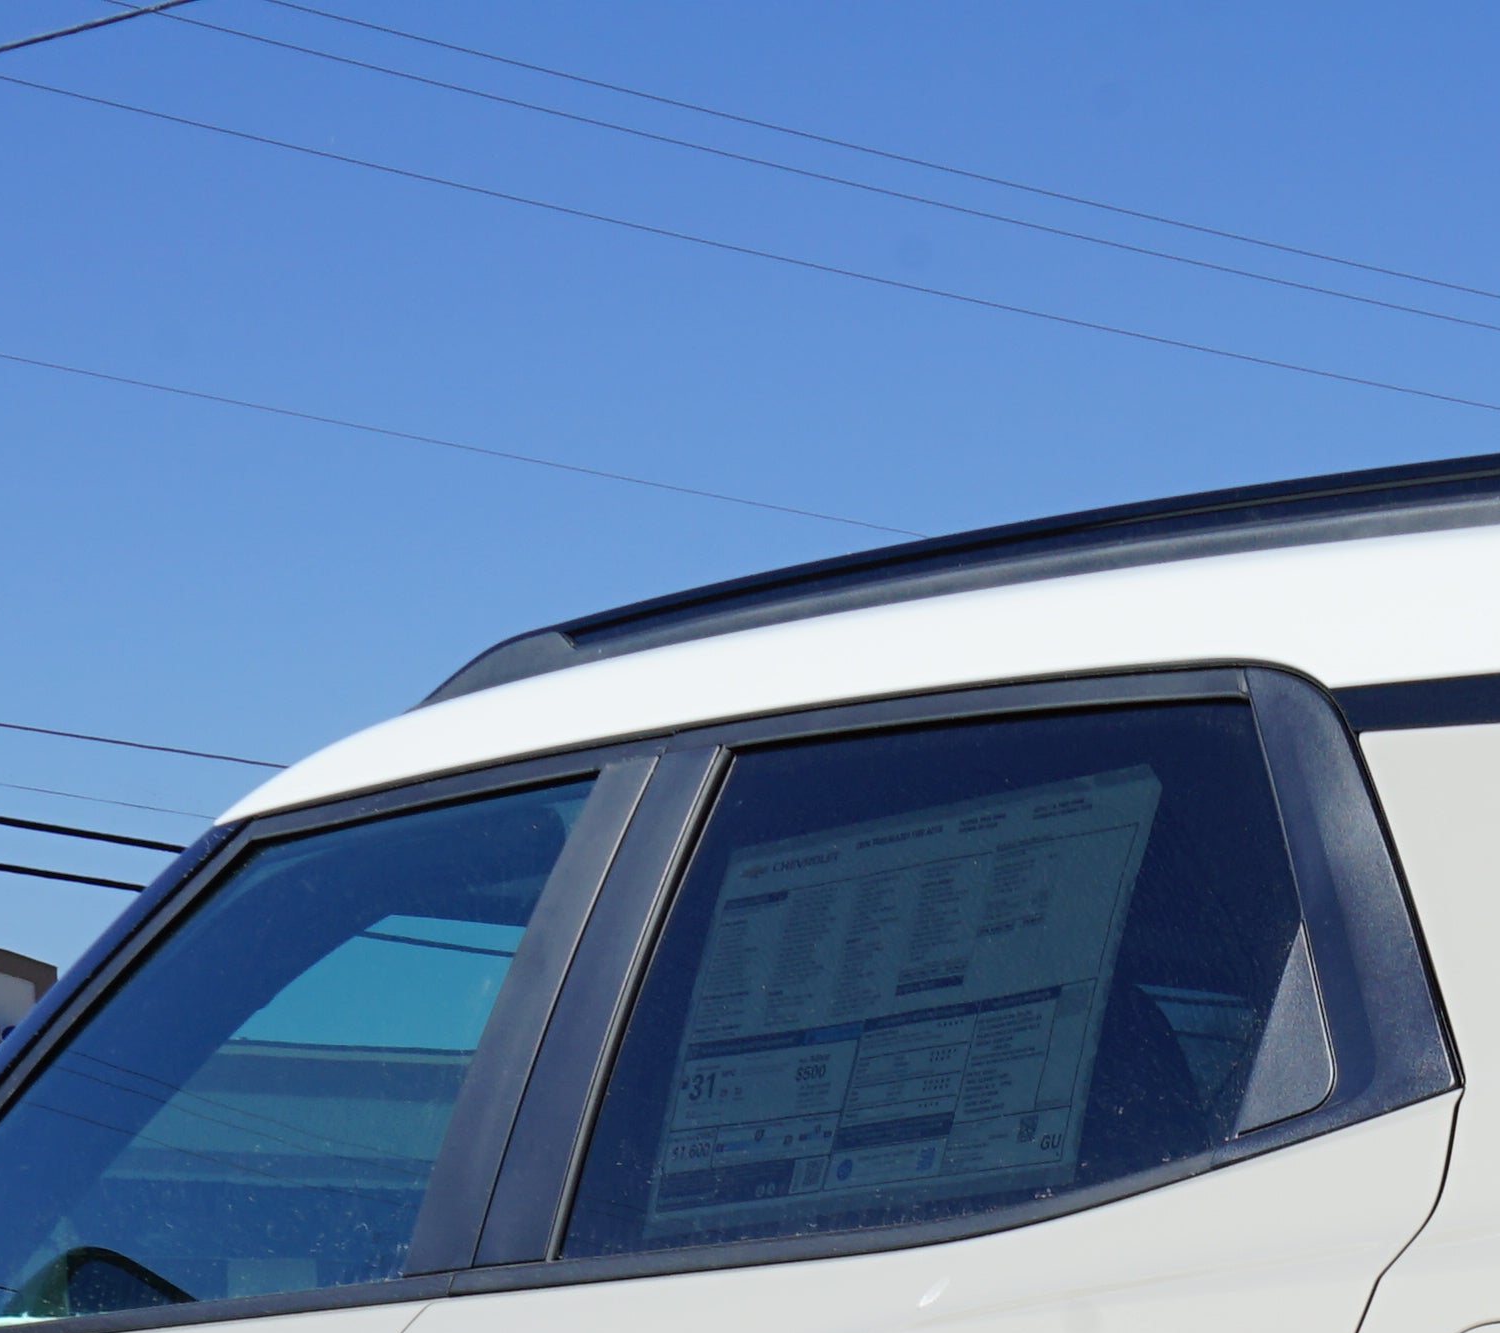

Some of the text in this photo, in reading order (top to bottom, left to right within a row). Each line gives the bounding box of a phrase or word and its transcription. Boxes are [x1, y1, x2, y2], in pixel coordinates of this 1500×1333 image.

[772, 850, 841, 873] CHEVROLET
[794, 1063, 827, 1083] $500
[1039, 1133, 1062, 1151] GU
